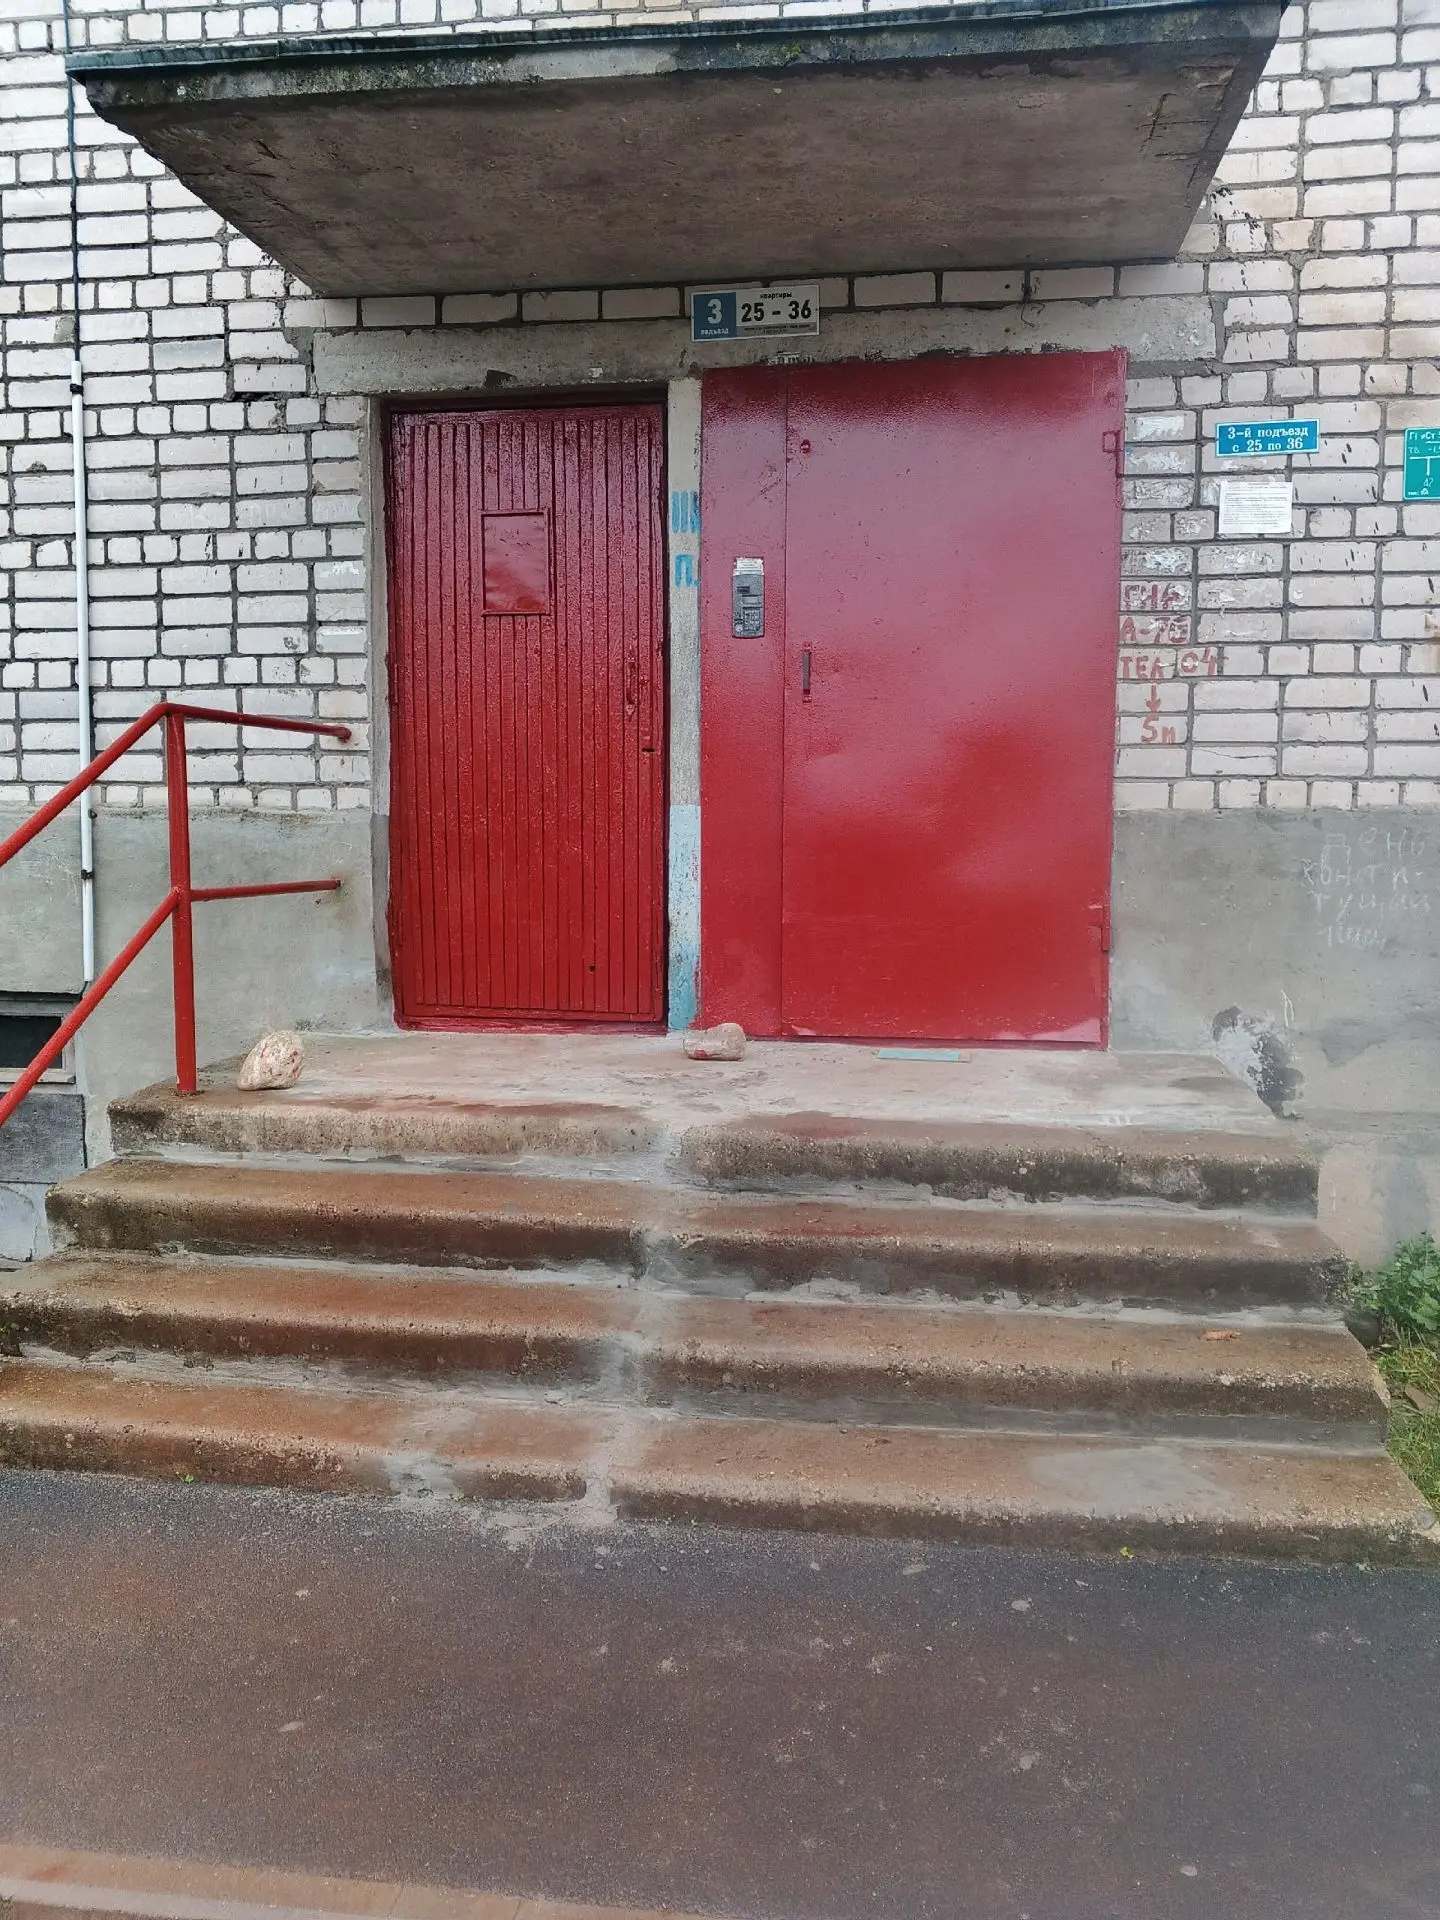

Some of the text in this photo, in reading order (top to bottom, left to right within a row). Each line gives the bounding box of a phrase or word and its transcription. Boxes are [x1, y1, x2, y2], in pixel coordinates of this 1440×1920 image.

[760, 291, 792, 300] квартиры
[707, 299, 722, 324] 3
[741, 302, 764, 322] 25
[788, 299, 812, 320] 36
[700, 327, 729, 336] подъезд
[1227, 427, 1309, 439] 3-й подъезд
[1232, 437, 1304, 453] с 25 по 36
